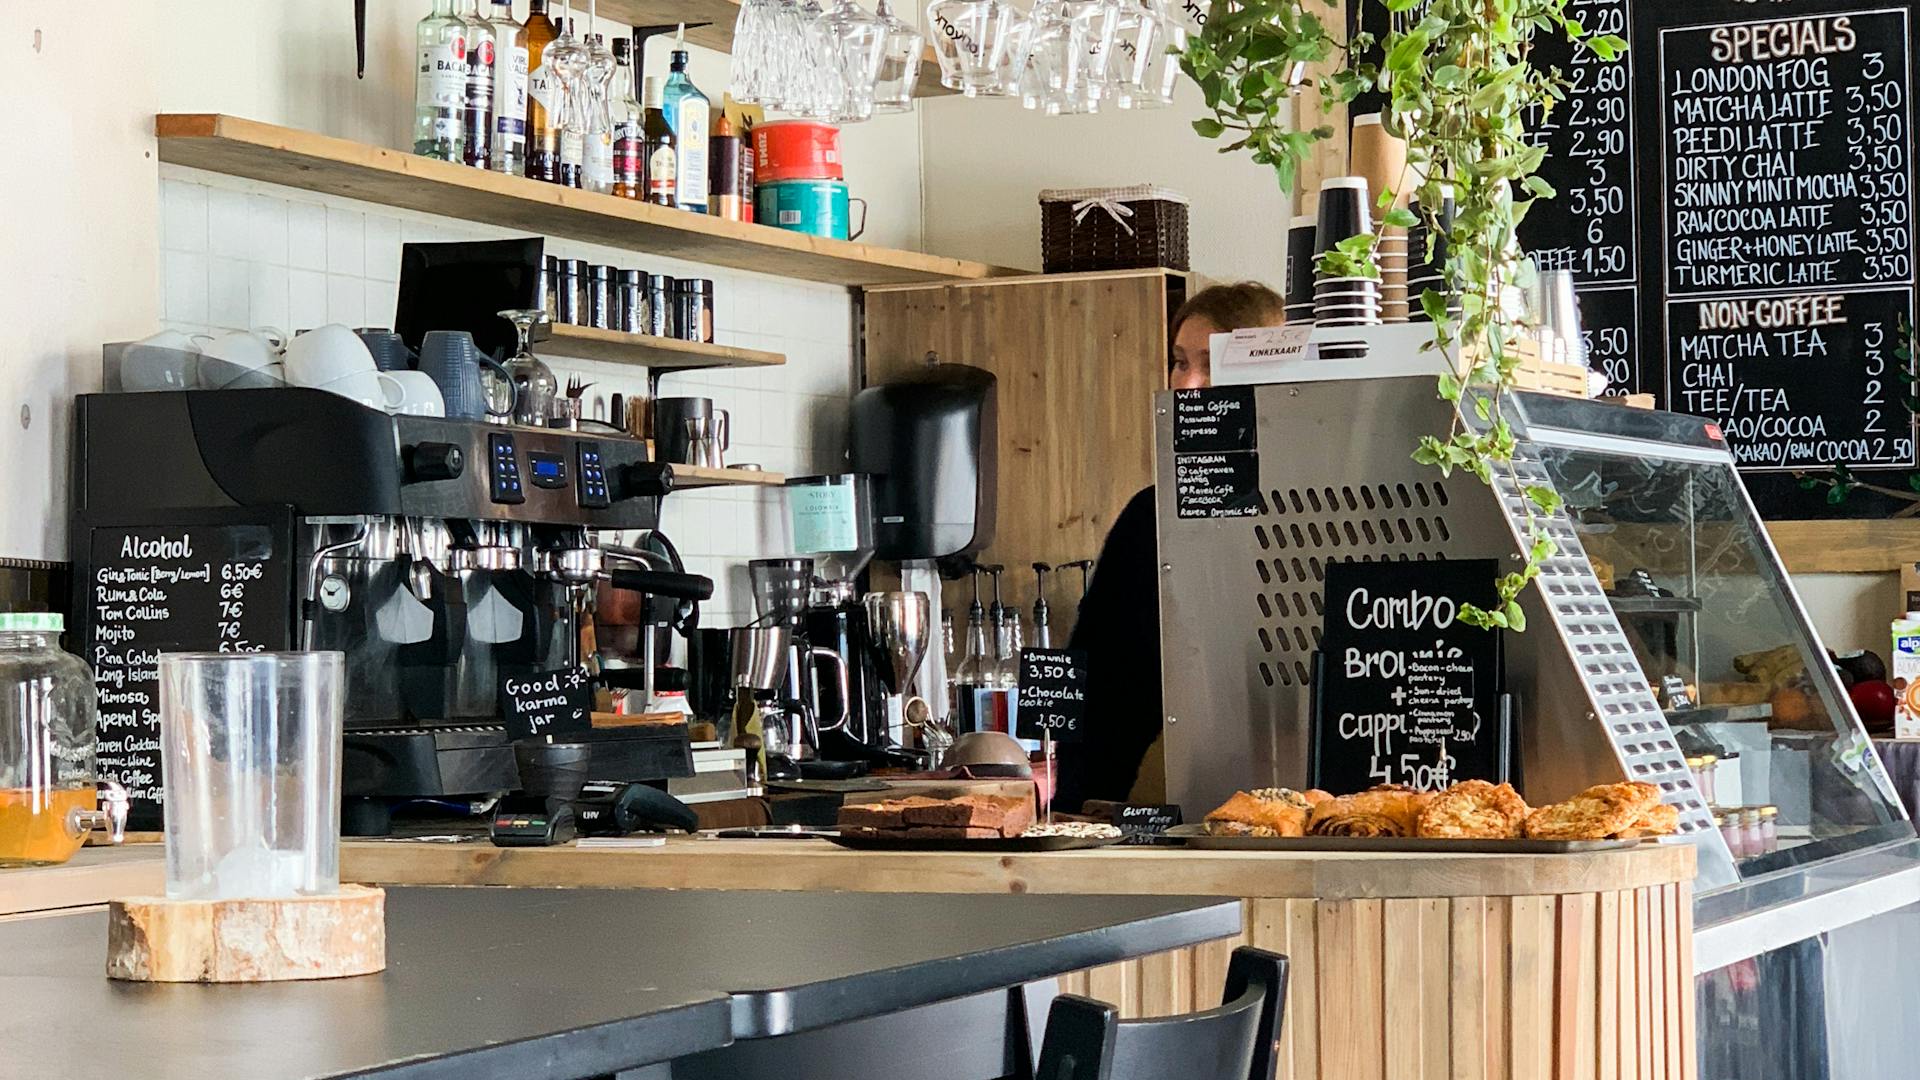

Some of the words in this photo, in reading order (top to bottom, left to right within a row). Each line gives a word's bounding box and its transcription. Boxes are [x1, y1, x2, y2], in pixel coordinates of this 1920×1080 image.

[1182, 0, 1208, 25] OLK
[1710, 17, 1857, 63] SPECIALS
[1570, 65, 1625, 94] 2,60
[1672, 63, 1774, 96] LONDON
[1776, 57, 1830, 89] FOG
[1862, 52, 1884, 79] 3
[1569, 97, 1625, 127] 2,90
[1673, 94, 1766, 124] MATCHA
[1767, 89, 1833, 121] LATTE
[1846, 80, 1901, 114] 3,50
[1569, 129, 1624, 157] 2,90
[1672, 126, 1741, 154] PEEDI
[1744, 120, 1824, 152] LATTE
[1847, 113, 1901, 145] 3,50
[1586, 159, 1606, 186] 3
[1676, 155, 1738, 180] DIRTY
[1742, 151, 1795, 178] CHAI
[1849, 144, 1902, 172] 3,50
[1570, 186, 1623, 216] 3,50
[1674, 180, 1743, 207] SKINNY
[1747, 177, 1794, 203] MINT
[1796, 172, 1858, 200] MOCHA
[1860, 172, 1906, 202] 3,50
[1781, 204, 1834, 230] LATTE
[1860, 200, 1907, 227] 3,50
[1587, 217, 1604, 244] 6
[1817, 229, 1867, 255] LATTE
[1866, 227, 1908, 255] 3,50
[1582, 245, 1626, 277] 1,50
[1674, 262, 1785, 287] TURMERIC
[1788, 259, 1840, 283] LATTE
[1862, 254, 1908, 280] 3,50
[1699, 295, 1848, 330] NON-COFFEE
[1249, 345, 1303, 357] KINKEKAART
[1680, 332, 1769, 361] MATCHA
[1773, 328, 1827, 357] TEA
[1864, 322, 1884, 348] 3
[1683, 362, 1733, 388] CHAI
[1865, 350, 1884, 376] 3
[1682, 383, 1790, 416] TEE/TEA
[1863, 380, 1885, 404] 2
[1864, 409, 1886, 432] 2
[1816, 439, 1870, 462] COCOA
[1873, 437, 1912, 463] 2,50
[121, 534, 192, 560] Alcohol
[221, 563, 263, 581] 6,50€
[220, 583, 244, 599] 6€
[97, 605, 123, 620] Tom
[126, 604, 170, 620] Collins
[219, 601, 243, 618] 7€
[1346, 587, 1456, 630] Combo
[95, 625, 135, 645] Mojito
[218, 621, 240, 639] 7€
[127, 648, 160, 665] Colad
[1029, 652, 1071, 664] Brownie
[95, 665, 125, 688] Long
[505, 674, 559, 696] Good
[1029, 665, 1064, 679] 3,50
[95, 686, 149, 705] Mimosa
[515, 695, 567, 713] karma
[1019, 698, 1054, 707] cookie
[1028, 686, 1084, 700] Chocolate
[97, 709, 138, 733] Aperol
[529, 712, 555, 734] jar
[125, 735, 160, 752] Cocktai
[127, 752, 155, 767] Wine
[121, 770, 153, 787] Coffee
[583, 811, 599, 819] LHV
